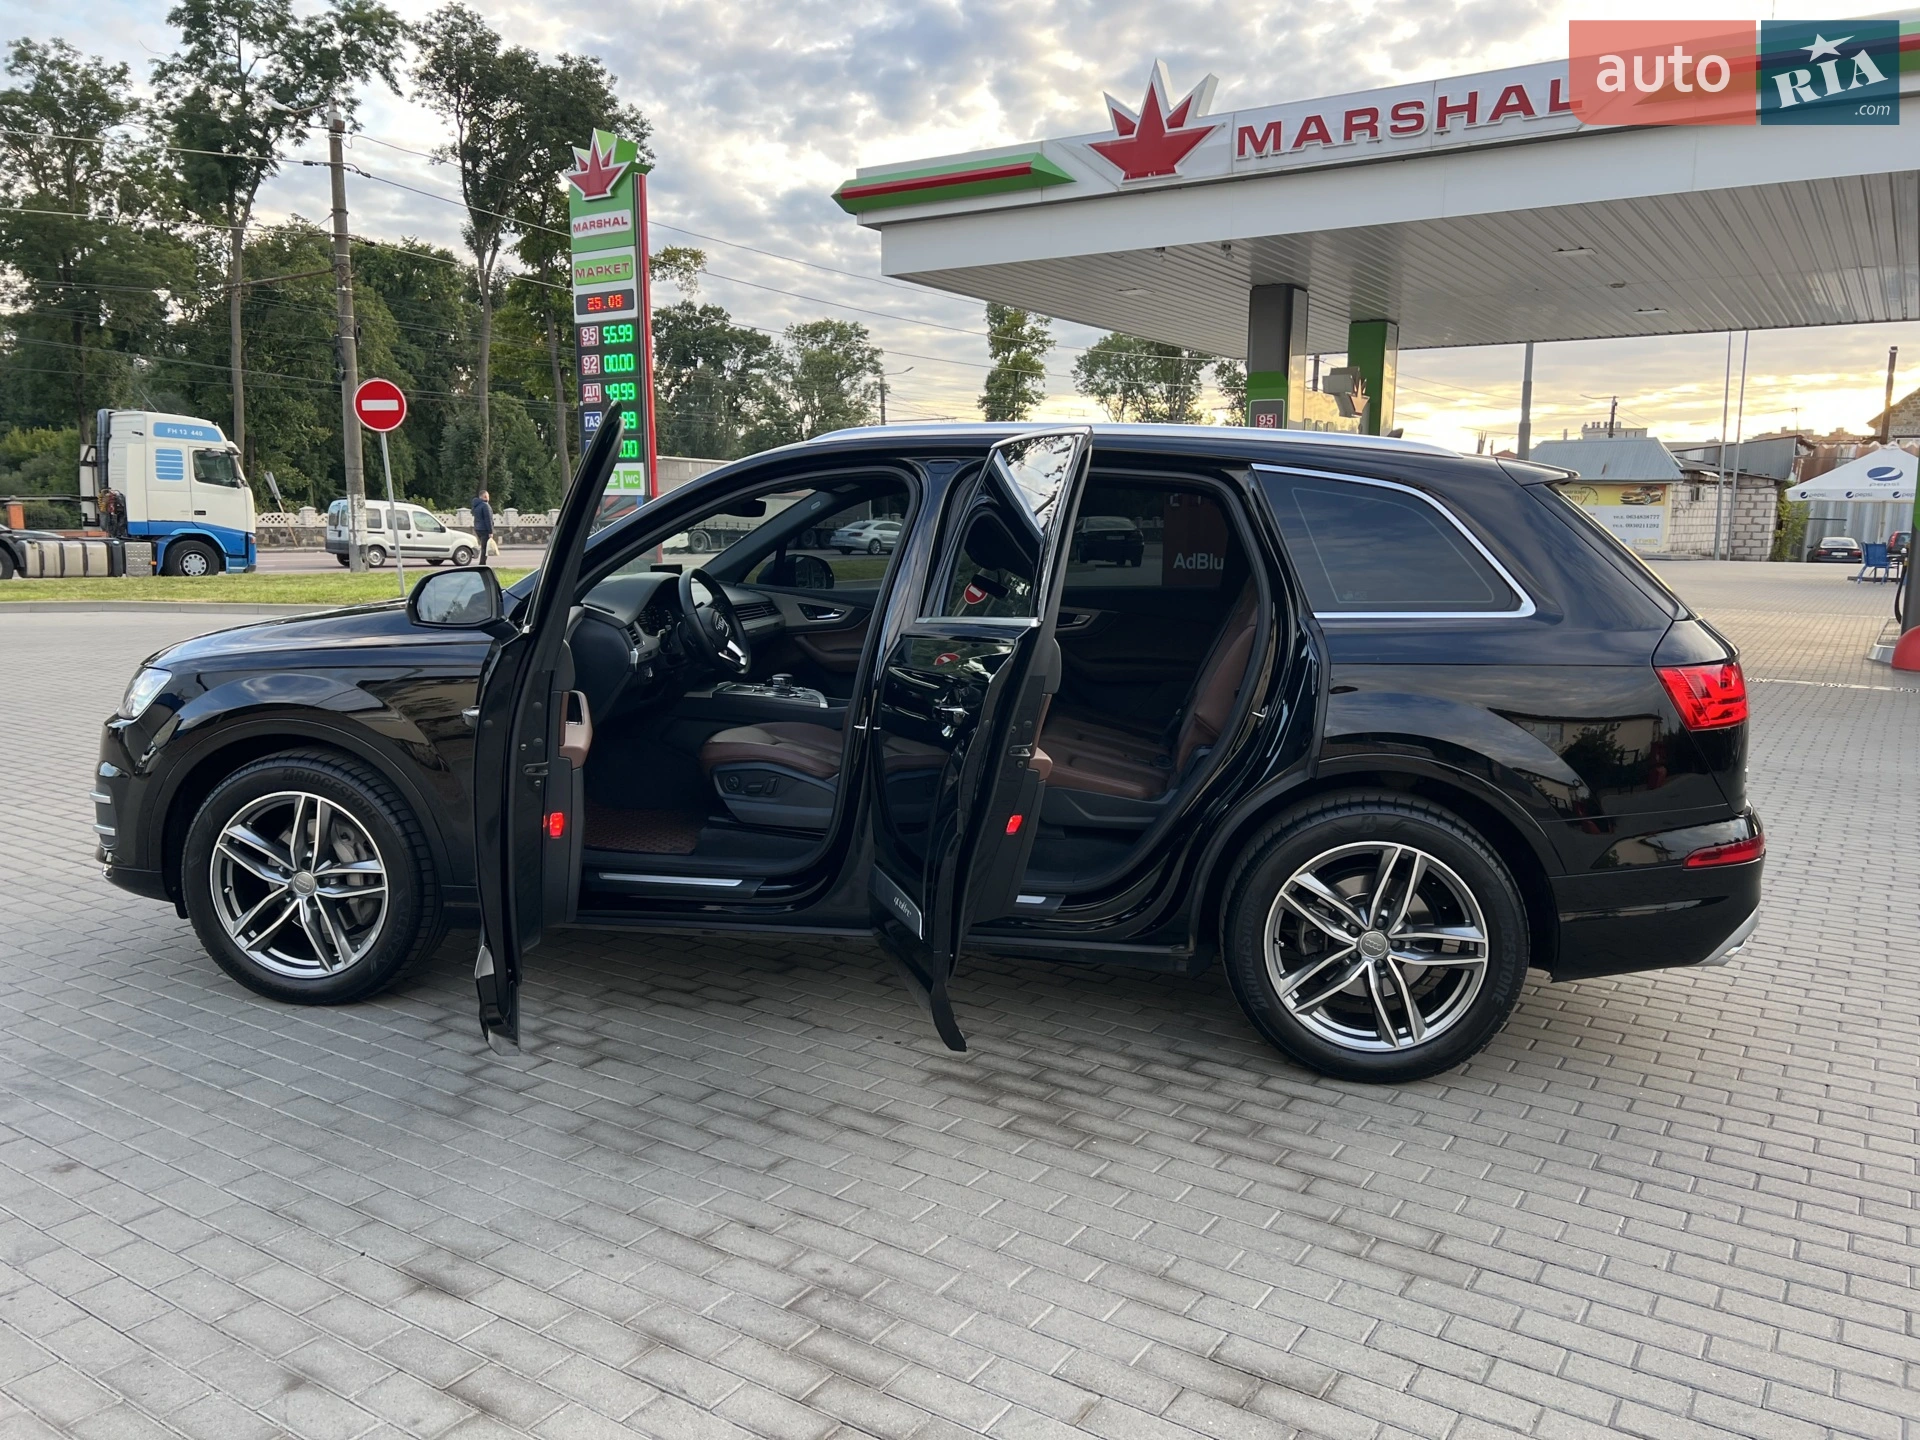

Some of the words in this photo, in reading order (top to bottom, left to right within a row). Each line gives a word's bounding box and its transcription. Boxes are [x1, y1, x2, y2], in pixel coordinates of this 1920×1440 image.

[1237, 78, 1583, 157] MARSHAL
[573, 216, 628, 233] MARSHAL
[587, 294, 624, 310] 25.08
[582, 328, 596, 341] 95
[603, 324, 633, 344] 55.99
[583, 356, 598, 370] 92
[604, 353, 634, 373] 00.00
[585, 385, 599, 397] ДП
[605, 382, 635, 400] 49.99
[585, 415, 600, 428] ГАЗ
[1258, 415, 1274, 425] 95
[625, 475, 639, 484] WC
[1172, 552, 1224, 570] AdBlu
